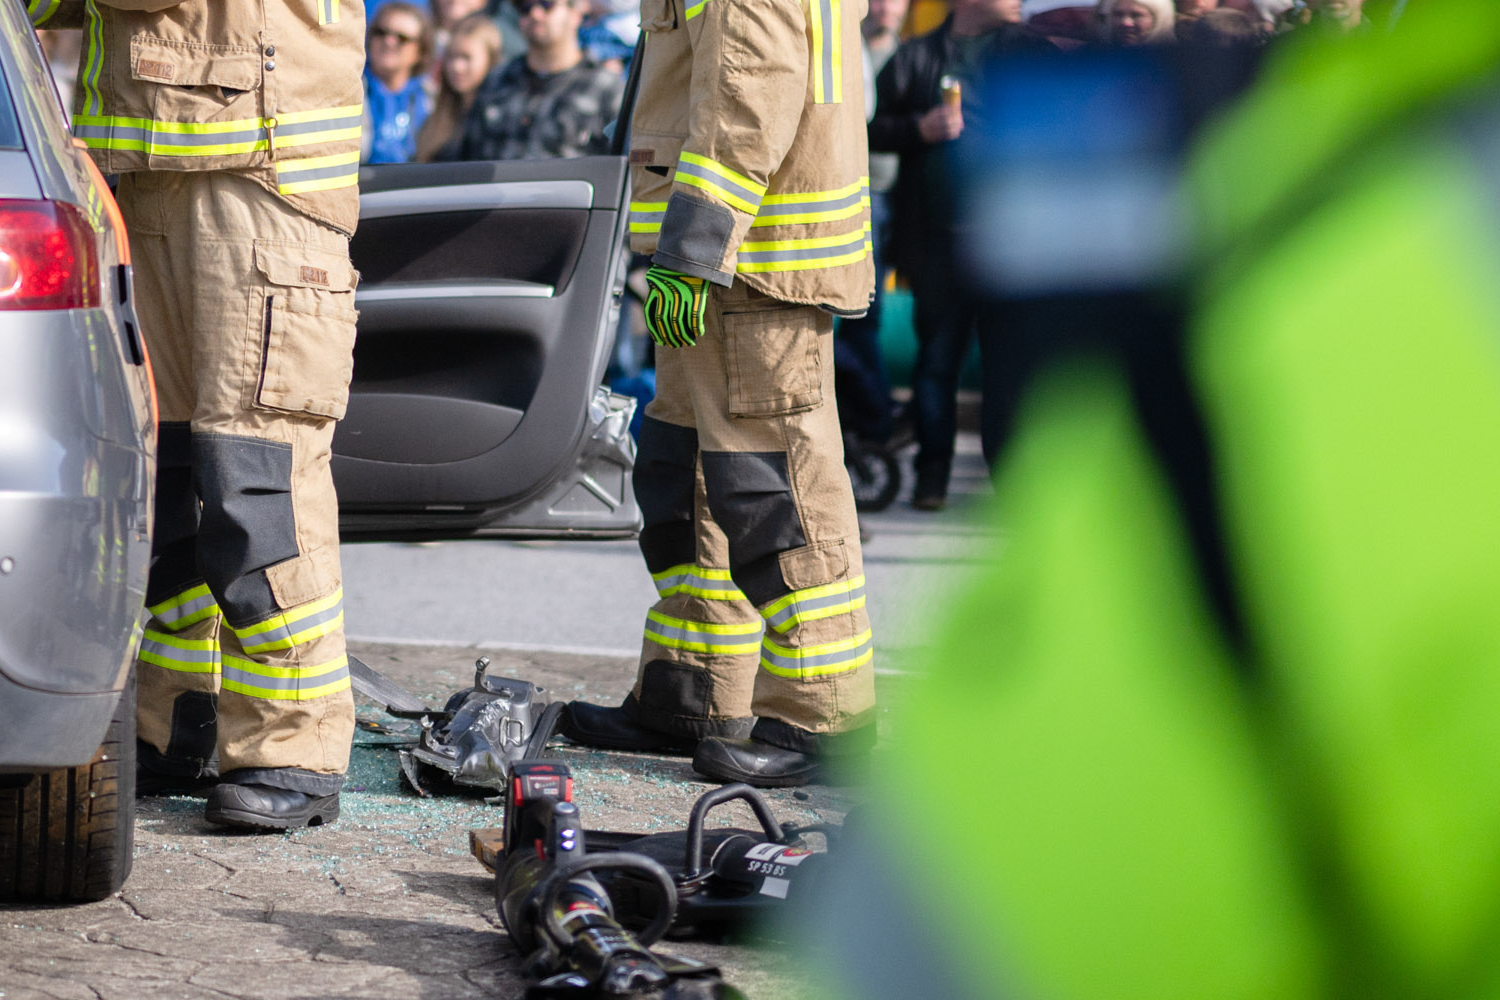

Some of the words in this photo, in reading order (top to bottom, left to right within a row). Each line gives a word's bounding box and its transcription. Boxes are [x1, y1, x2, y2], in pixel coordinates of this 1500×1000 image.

[747, 860, 761, 871] SP
[760, 862, 773, 874] 53
[773, 865, 786, 876] BS
